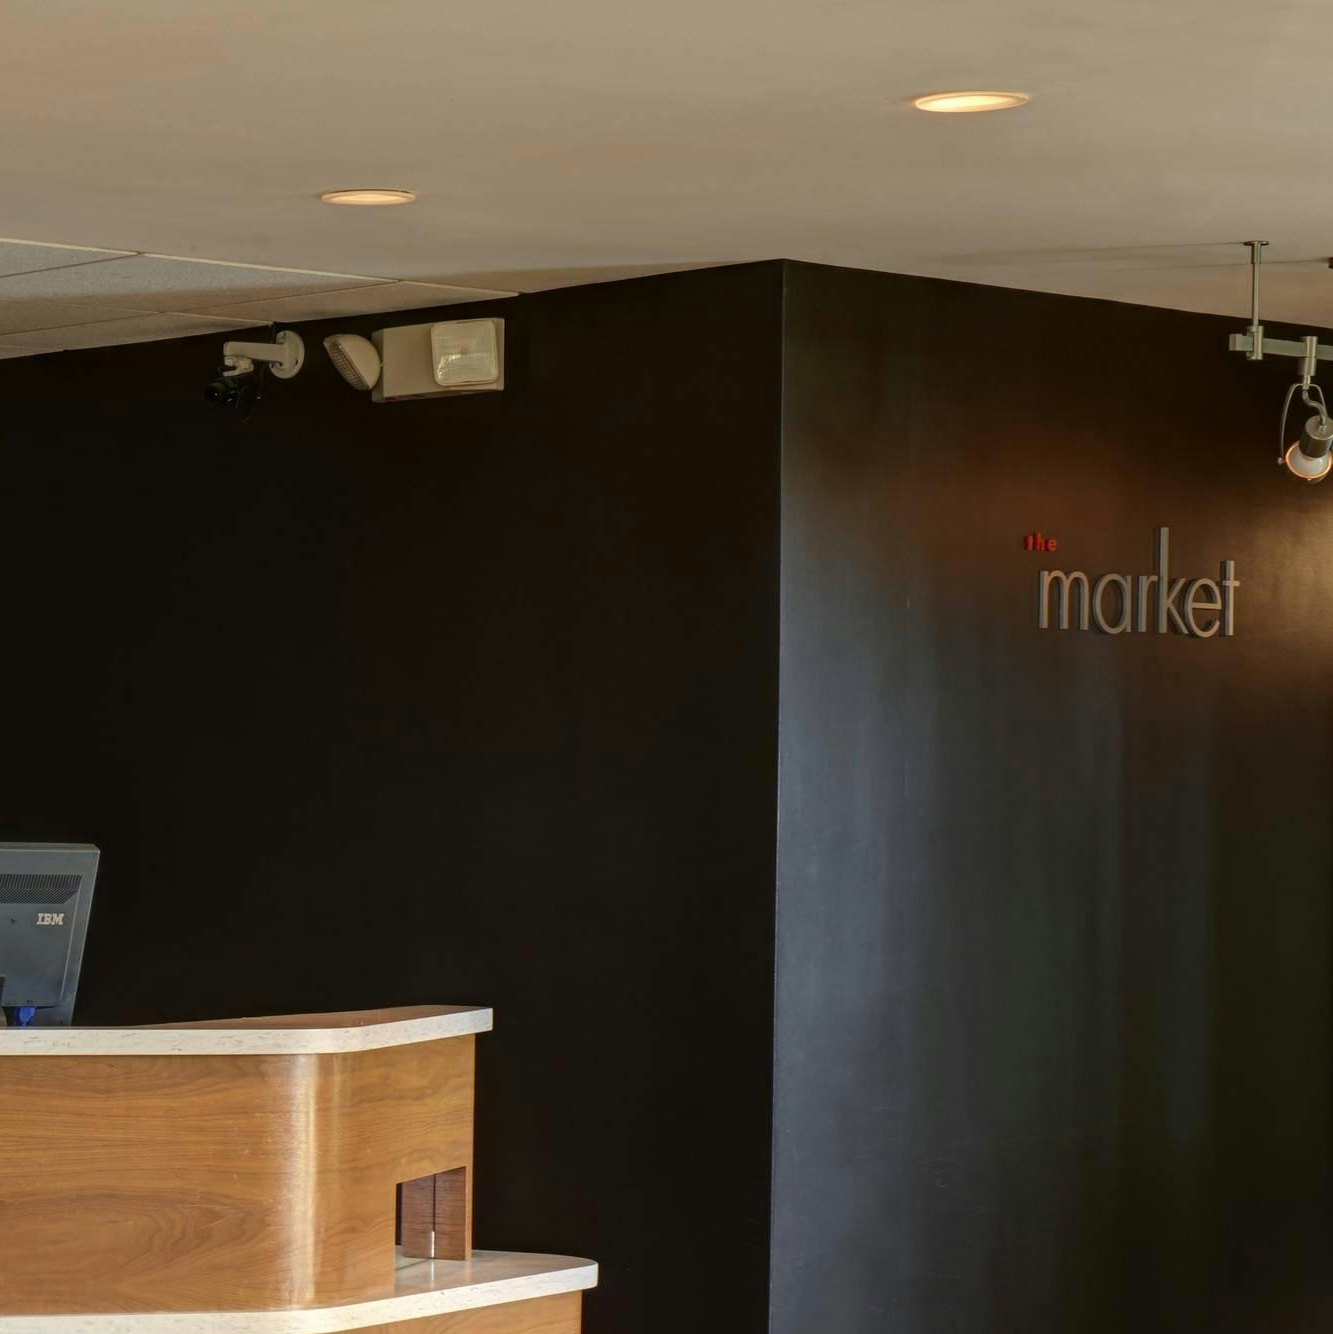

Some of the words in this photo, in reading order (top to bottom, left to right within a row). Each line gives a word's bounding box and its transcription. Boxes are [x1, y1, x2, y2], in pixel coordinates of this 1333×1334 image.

[1024, 532, 1058, 552] the
[1038, 527, 1240, 638] market
[36, 912, 65, 926] IBM
